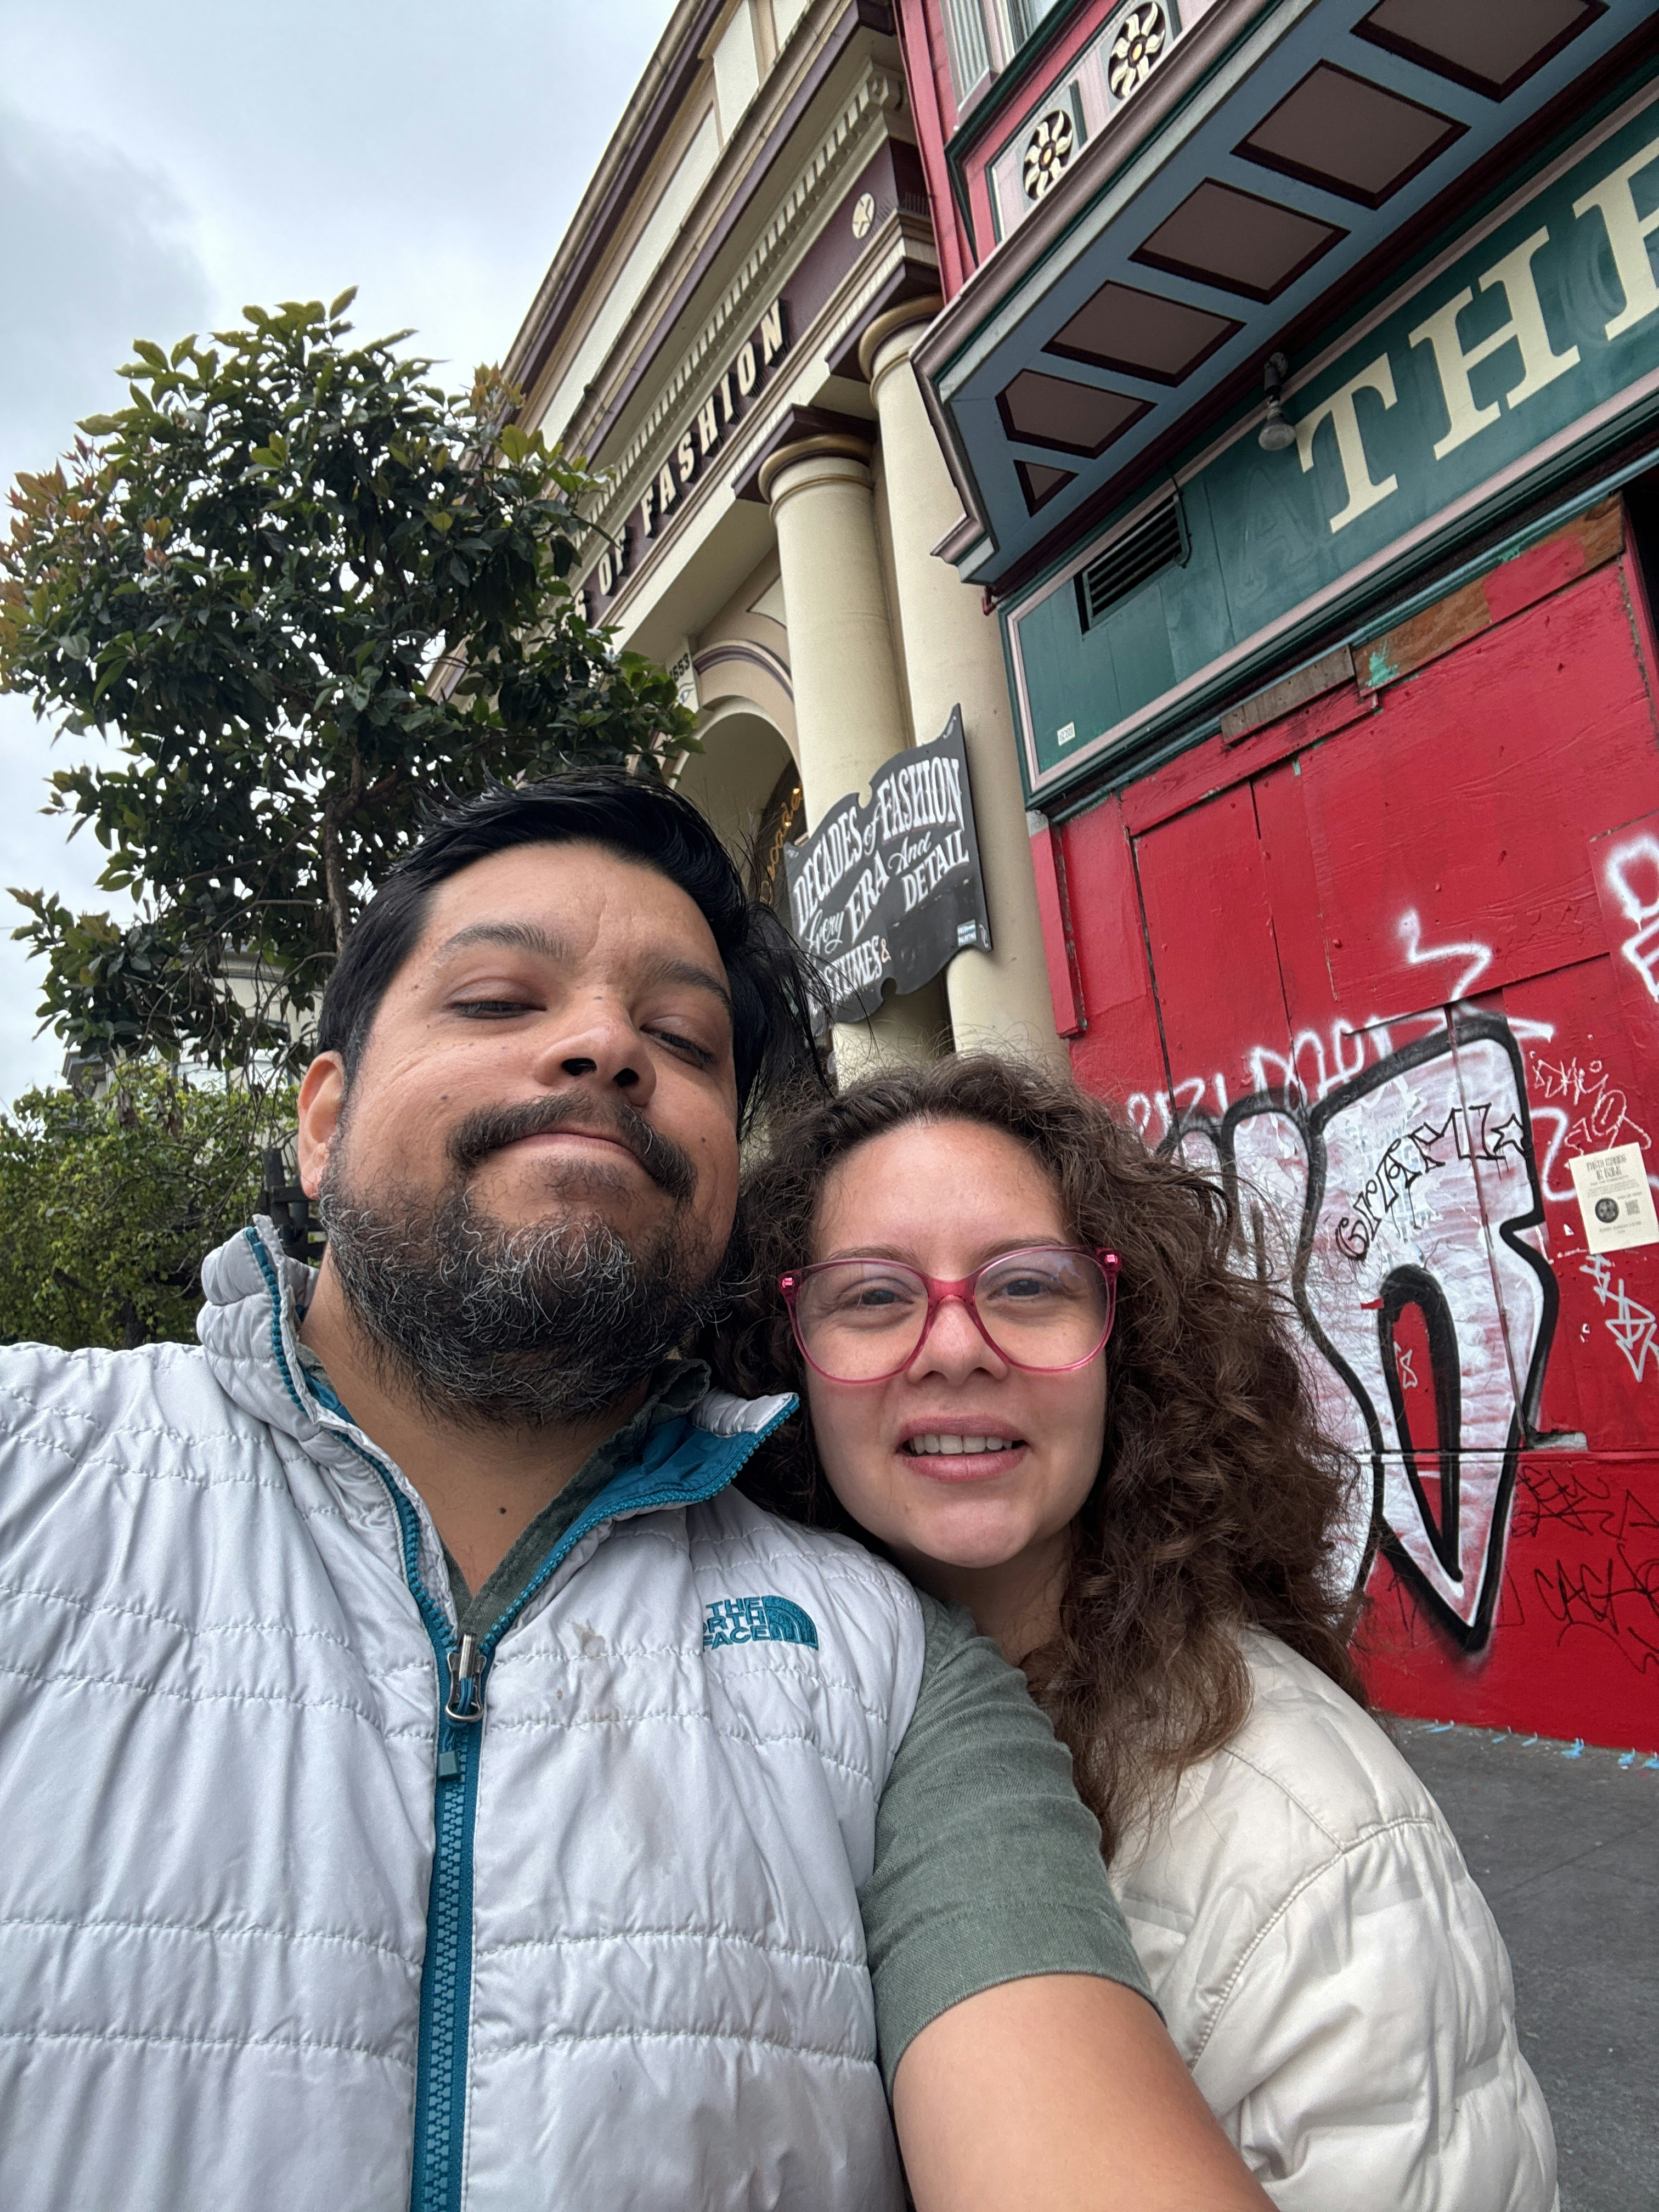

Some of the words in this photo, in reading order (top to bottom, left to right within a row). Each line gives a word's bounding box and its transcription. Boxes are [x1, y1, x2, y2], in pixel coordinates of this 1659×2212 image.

[598, 524, 627, 596] OF
[640, 298, 787, 538] FASHION
[793, 806, 863, 936] DECADES
[862, 802, 882, 856] of
[877, 757, 964, 842] FASHION
[888, 832, 931, 876] And
[901, 829, 969, 912] DETAIL
[845, 850, 890, 944] ERA
[805, 909, 844, 956] Every
[881, 937, 891, 963] &
[703, 1609, 766, 1634] RTH
[706, 1596, 763, 1617] THE
